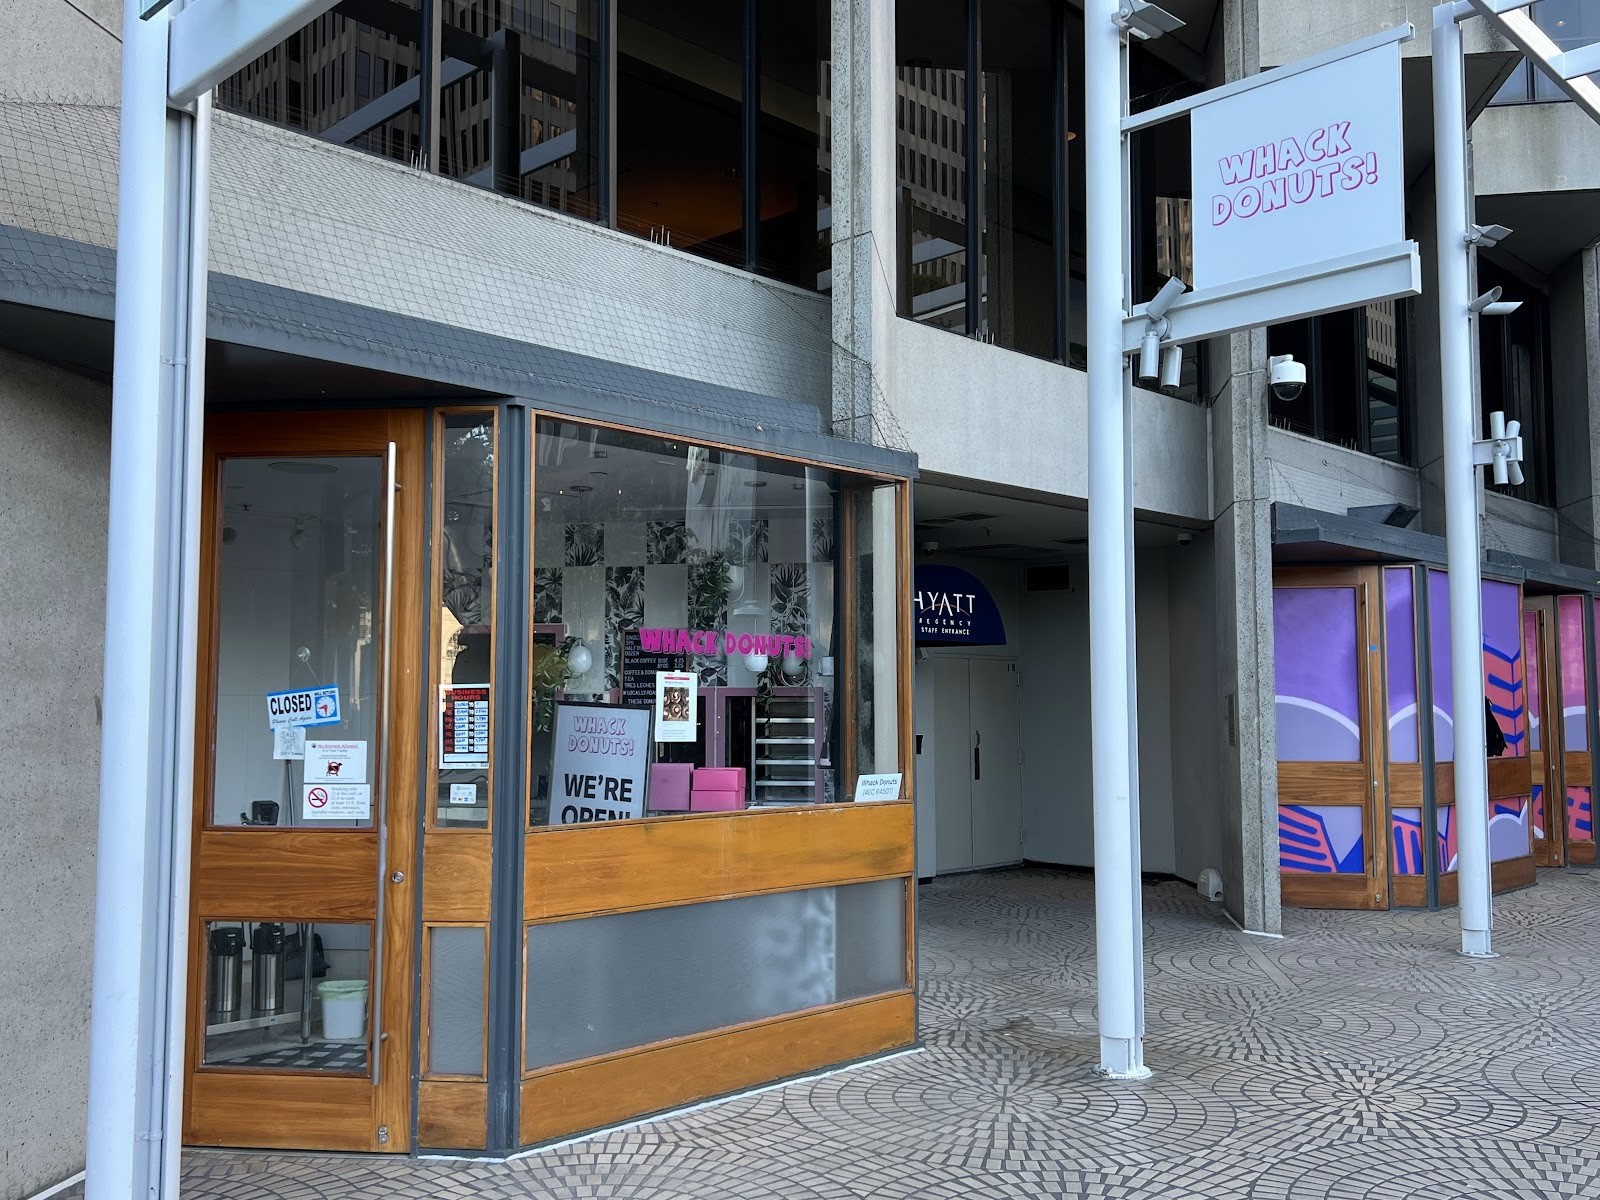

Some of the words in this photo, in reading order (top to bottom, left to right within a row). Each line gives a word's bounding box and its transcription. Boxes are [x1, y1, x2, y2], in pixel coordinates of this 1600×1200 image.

[1218, 121, 1352, 185] WHACK
[1212, 152, 1378, 226] DONUTS!
[914, 591, 976, 616] HYATT
[919, 617, 972, 626] REGENCY
[639, 627, 720, 656] WHACK
[725, 631, 813, 660] DONUTS!
[270, 693, 312, 716] CLOSED
[574, 715, 627, 736] WHACK
[567, 735, 635, 757] DONUTS!
[564, 773, 633, 803] WE'RE
